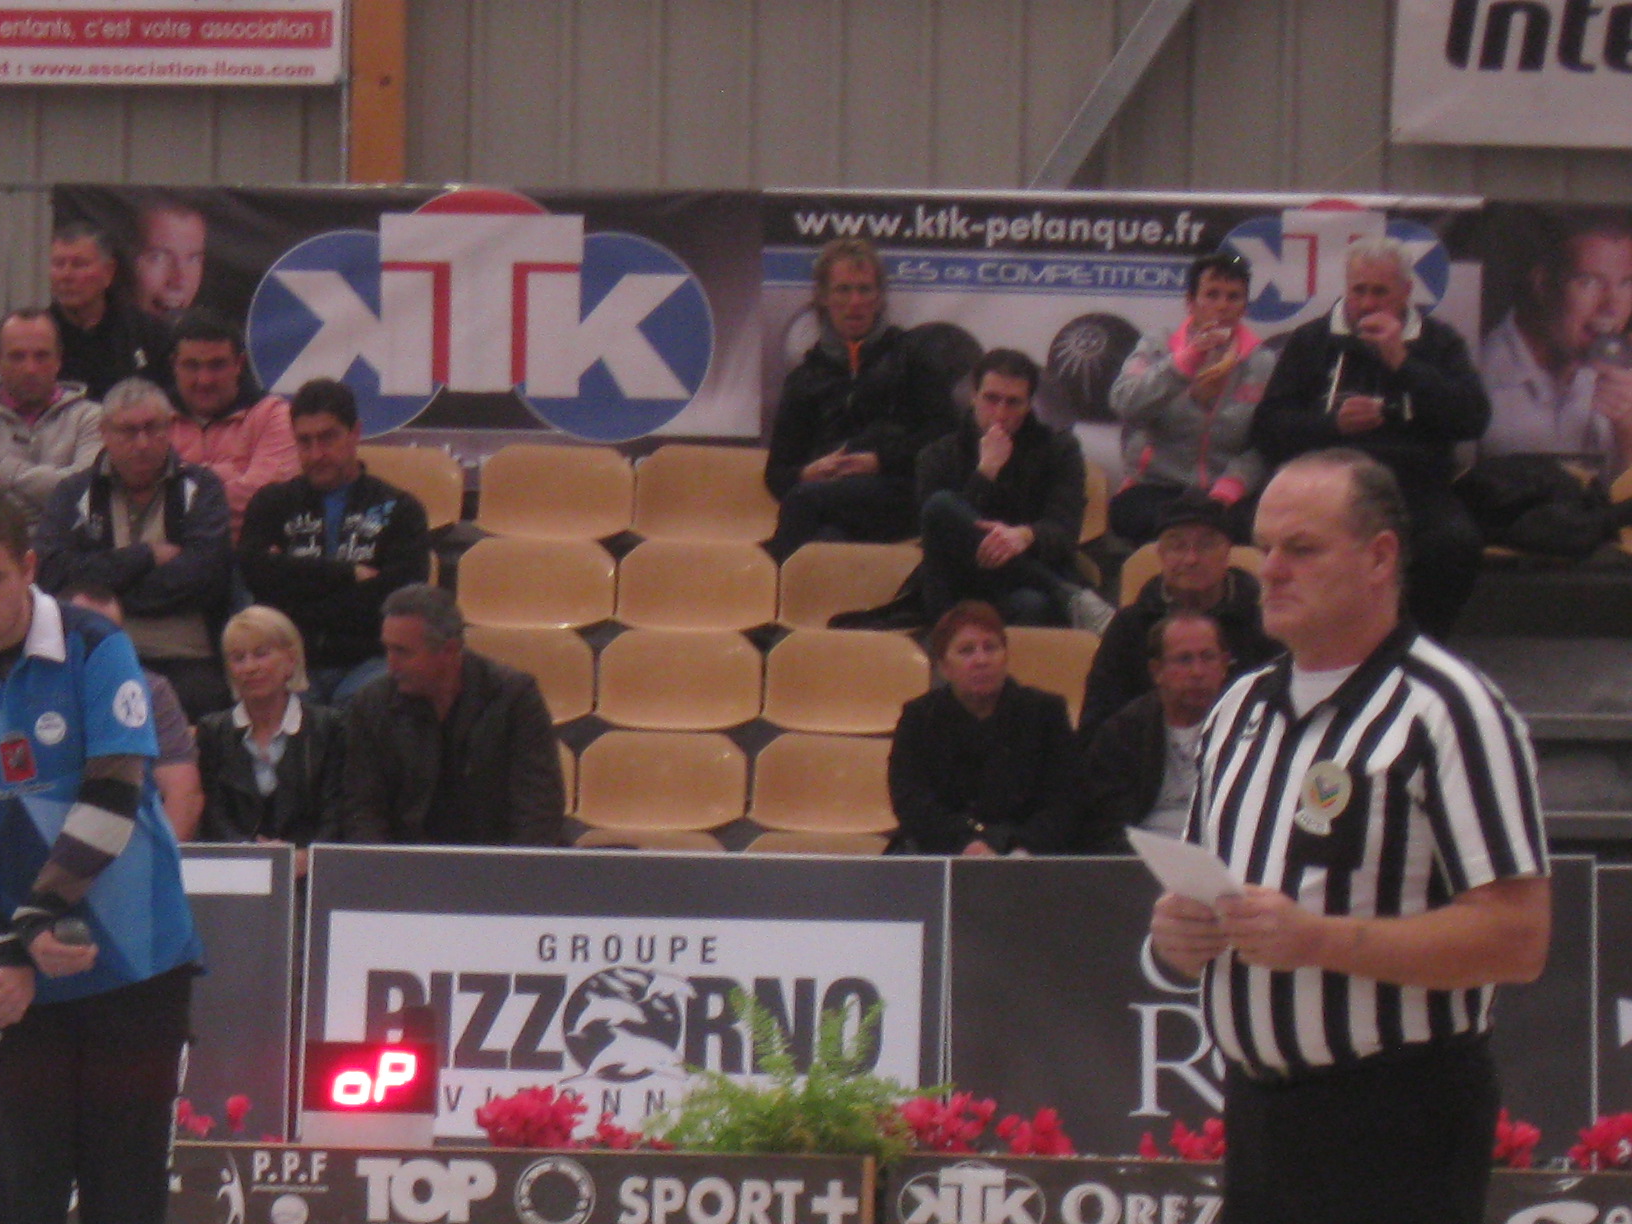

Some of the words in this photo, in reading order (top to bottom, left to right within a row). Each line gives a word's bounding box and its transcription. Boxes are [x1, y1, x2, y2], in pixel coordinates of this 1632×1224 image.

[0, 18, 76, 41] enfants,
[84, 19, 131, 39] c'est
[140, 20, 192, 38] votre
[199, 18, 314, 40] association
[795, 204, 1206, 252] www.ktk-petanque.fr
[977, 261, 1186, 288] COMPETITION
[539, 934, 718, 964] GROUPE
[355, 1157, 497, 1224] TOP
